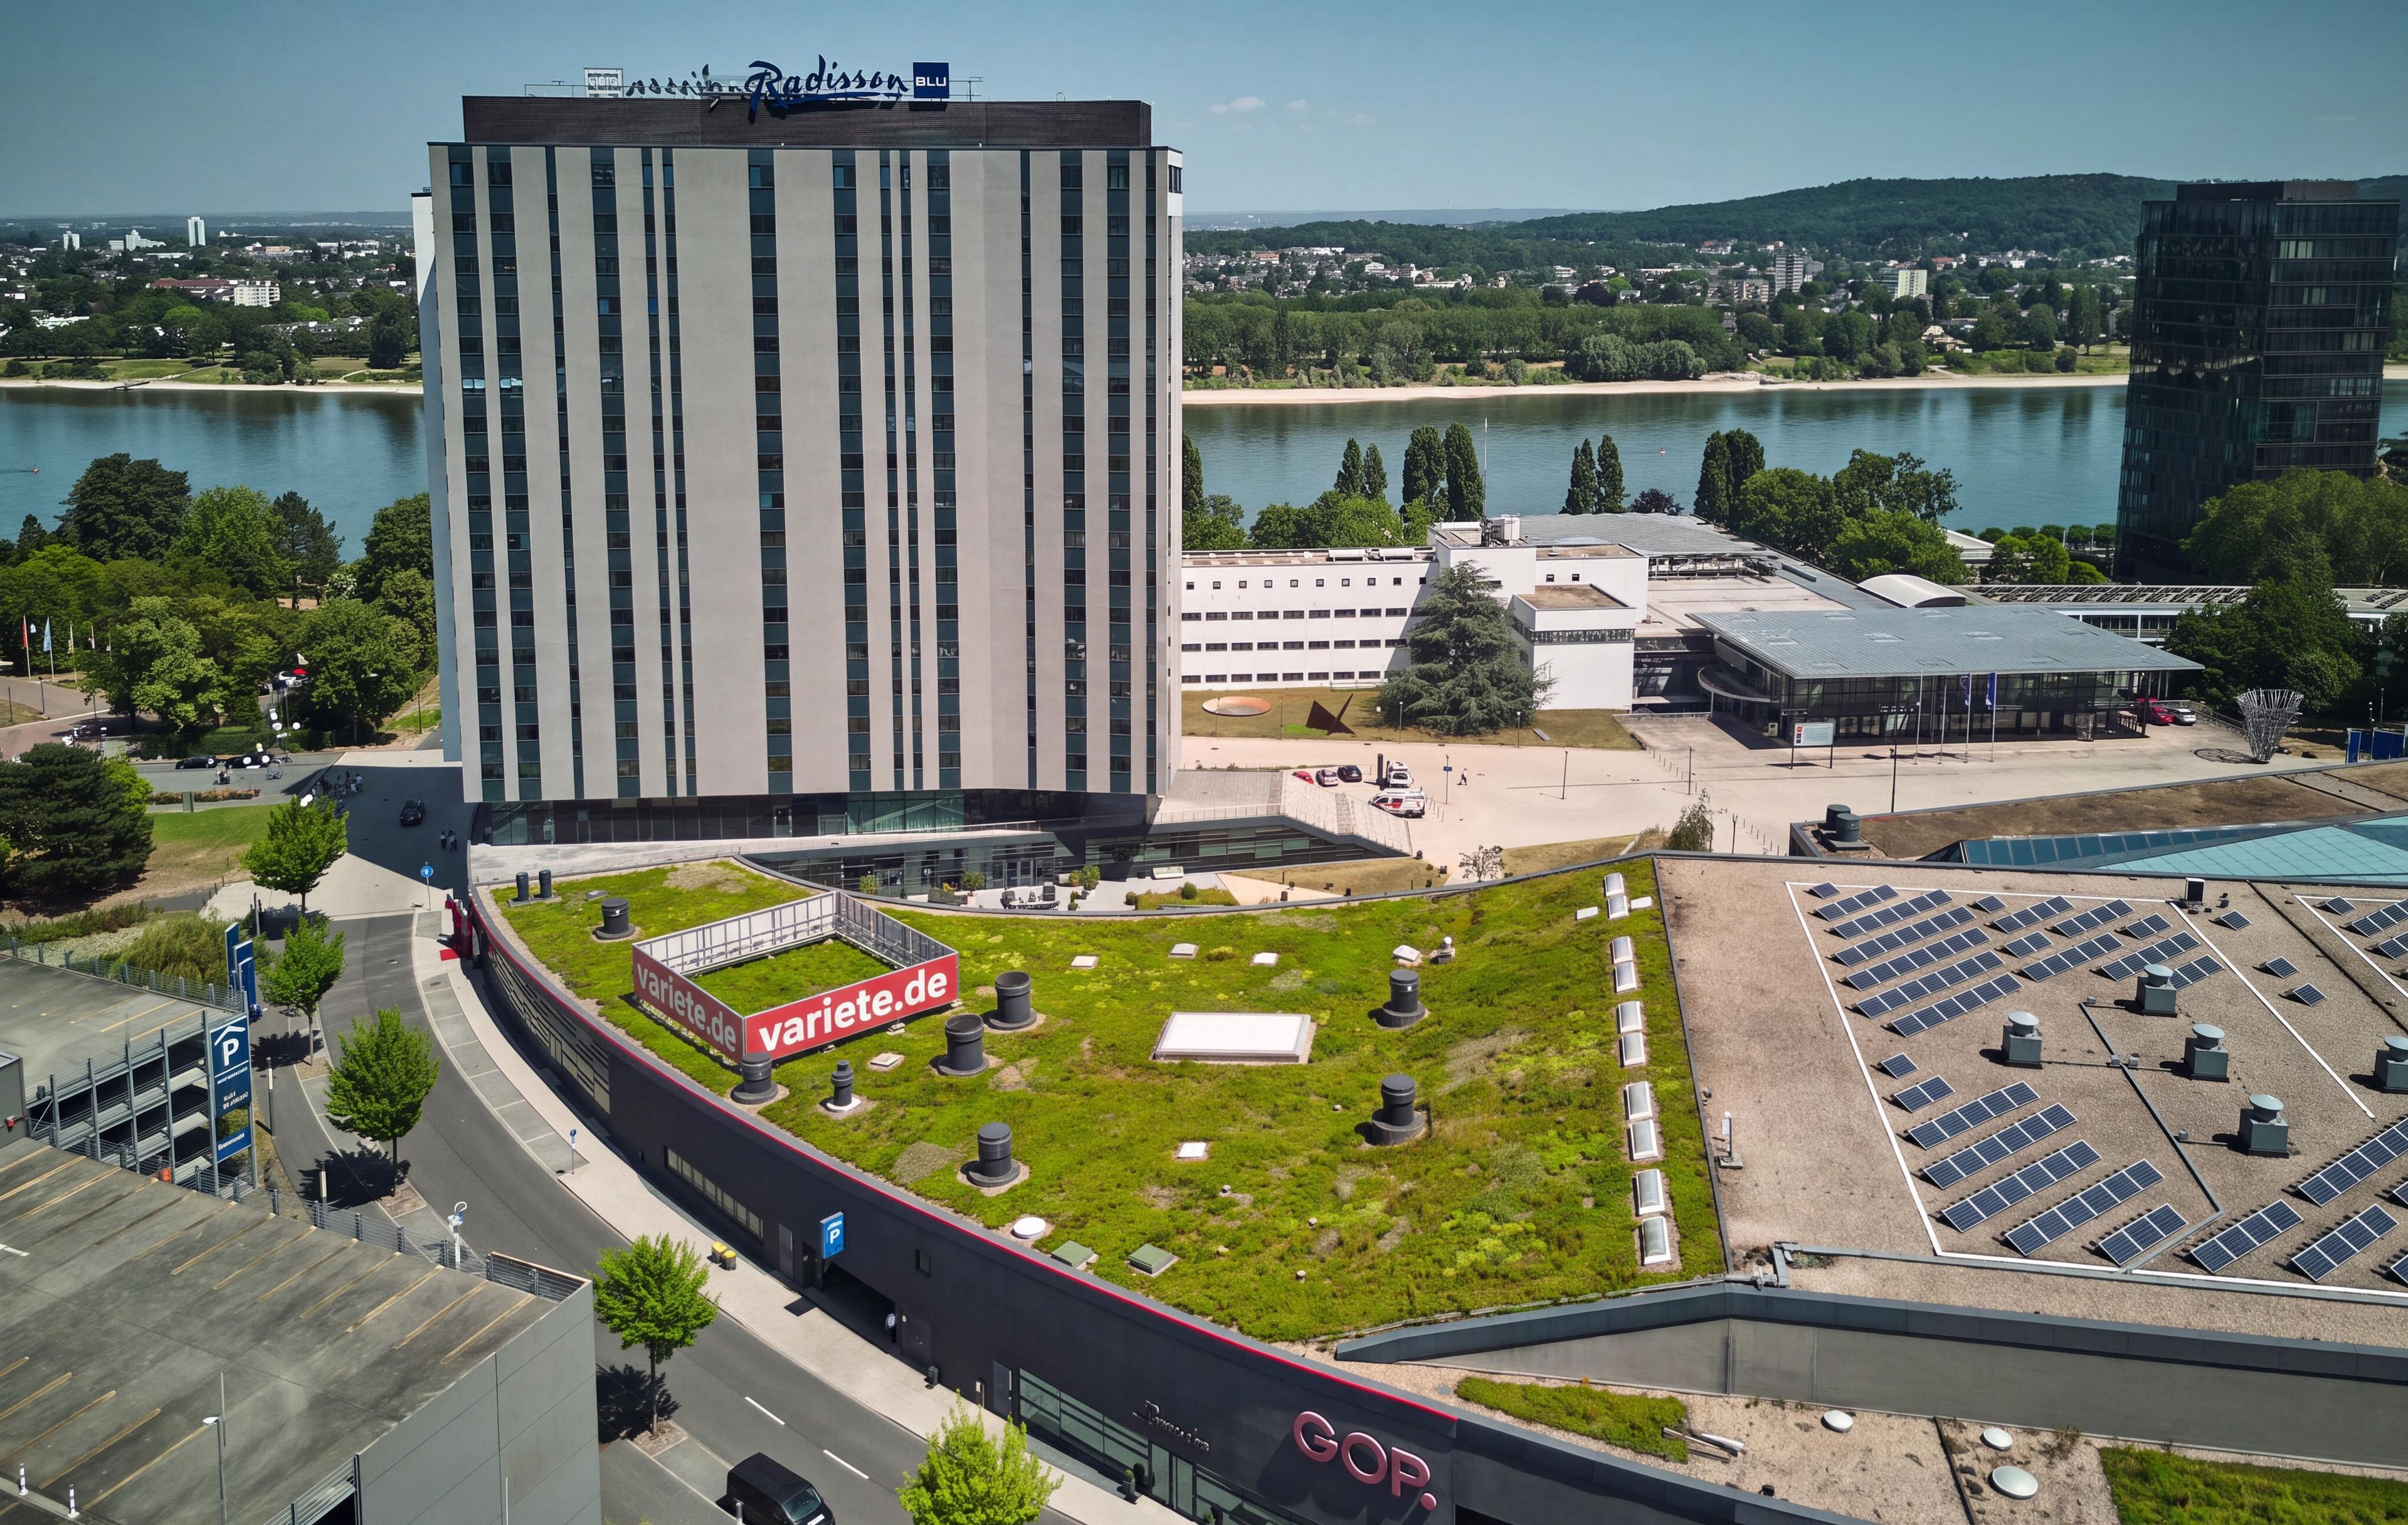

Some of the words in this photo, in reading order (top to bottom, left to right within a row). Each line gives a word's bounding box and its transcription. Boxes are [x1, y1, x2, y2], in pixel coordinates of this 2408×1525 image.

[744, 54, 909, 113] Radisson
[916, 77, 946, 87] BLU
[636, 963, 736, 1052] variete.de
[759, 969, 948, 1052] variete.de
[222, 1038, 239, 1066] P
[1293, 1411, 1437, 1511] GOP.
